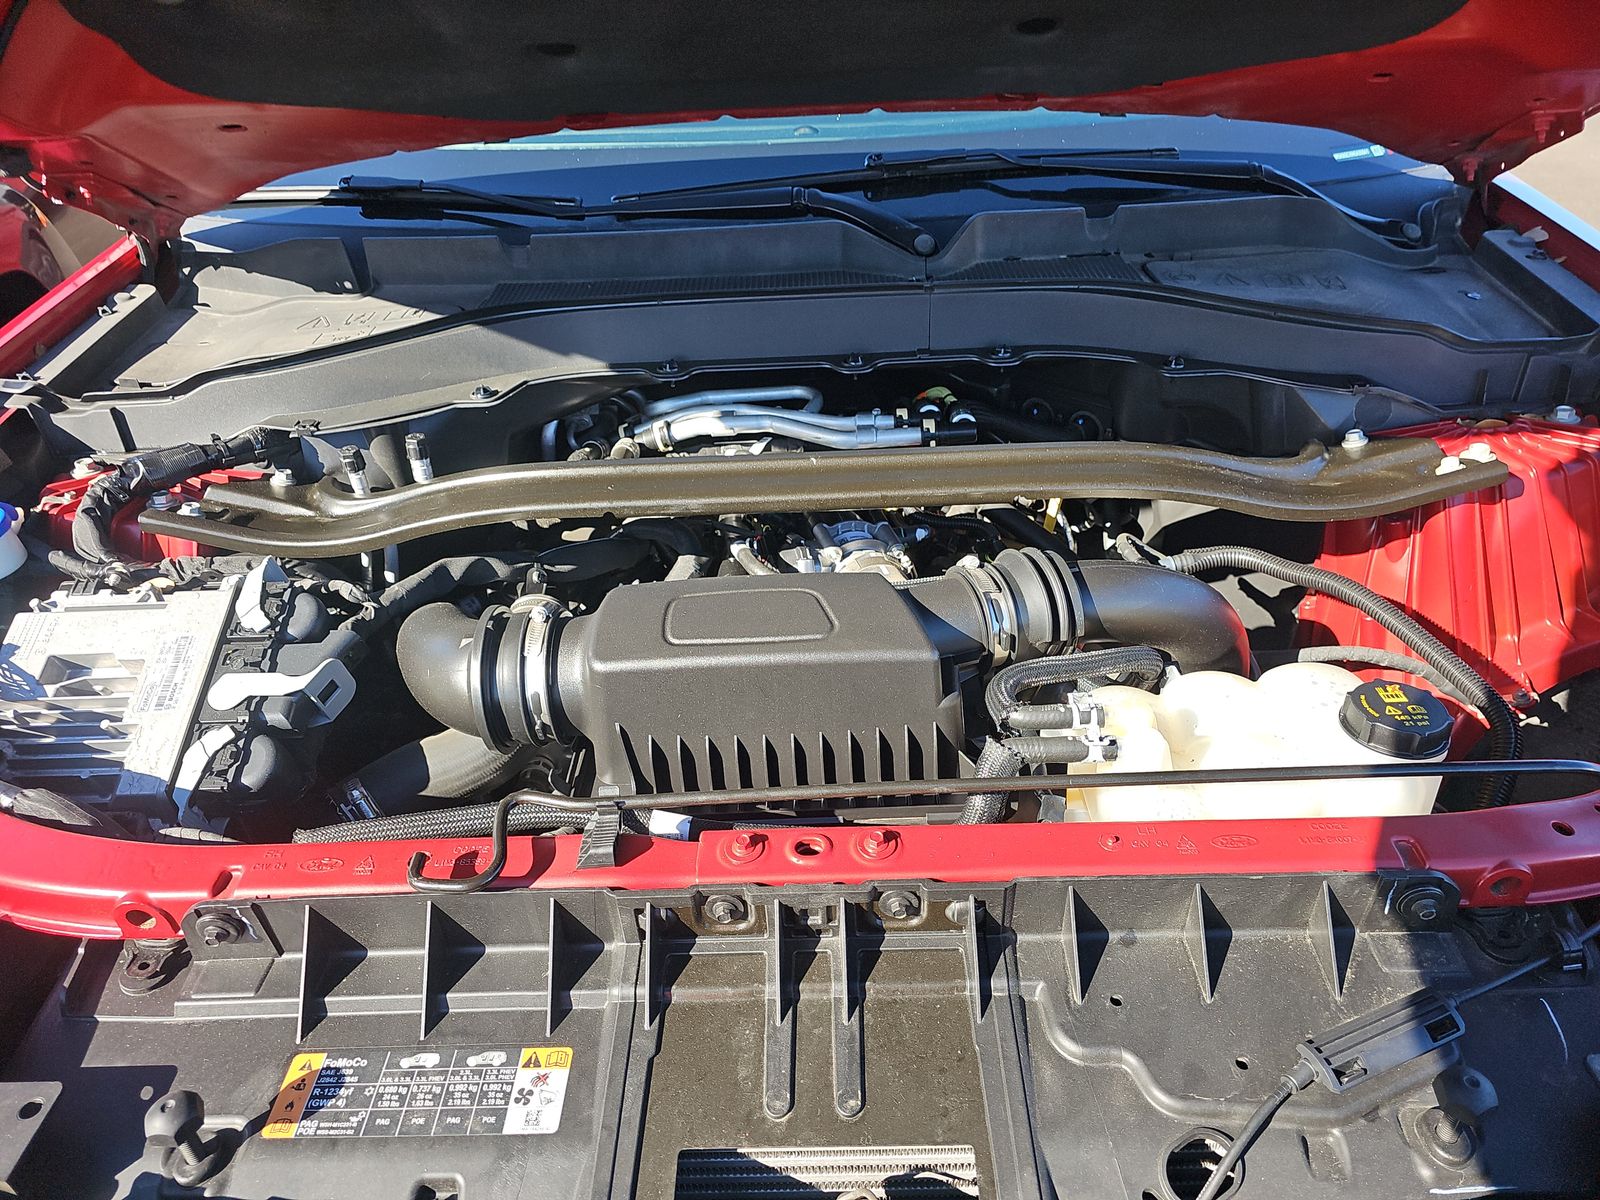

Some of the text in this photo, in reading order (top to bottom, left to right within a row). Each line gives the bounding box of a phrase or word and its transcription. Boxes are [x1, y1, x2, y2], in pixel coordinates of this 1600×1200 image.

[168, 682, 179, 701] BOSCH
[323, 1057, 368, 1068] FoMoCo
[313, 1087, 354, 1097] R-1234yf
[398, 1086, 409, 1095] kg
[412, 1084, 442, 1094] 0.737 kg
[449, 1083, 479, 1093] 0.992 kg
[483, 1083, 512, 1093] 0.992 kg
[308, 1098, 347, 1108] (GWP 4)
[299, 1120, 318, 1128] PAG
[411, 1117, 426, 1125] POE
[446, 1116, 461, 1124] PAG
[481, 1115, 497, 1124] POE
[296, 1127, 317, 1136] POE
